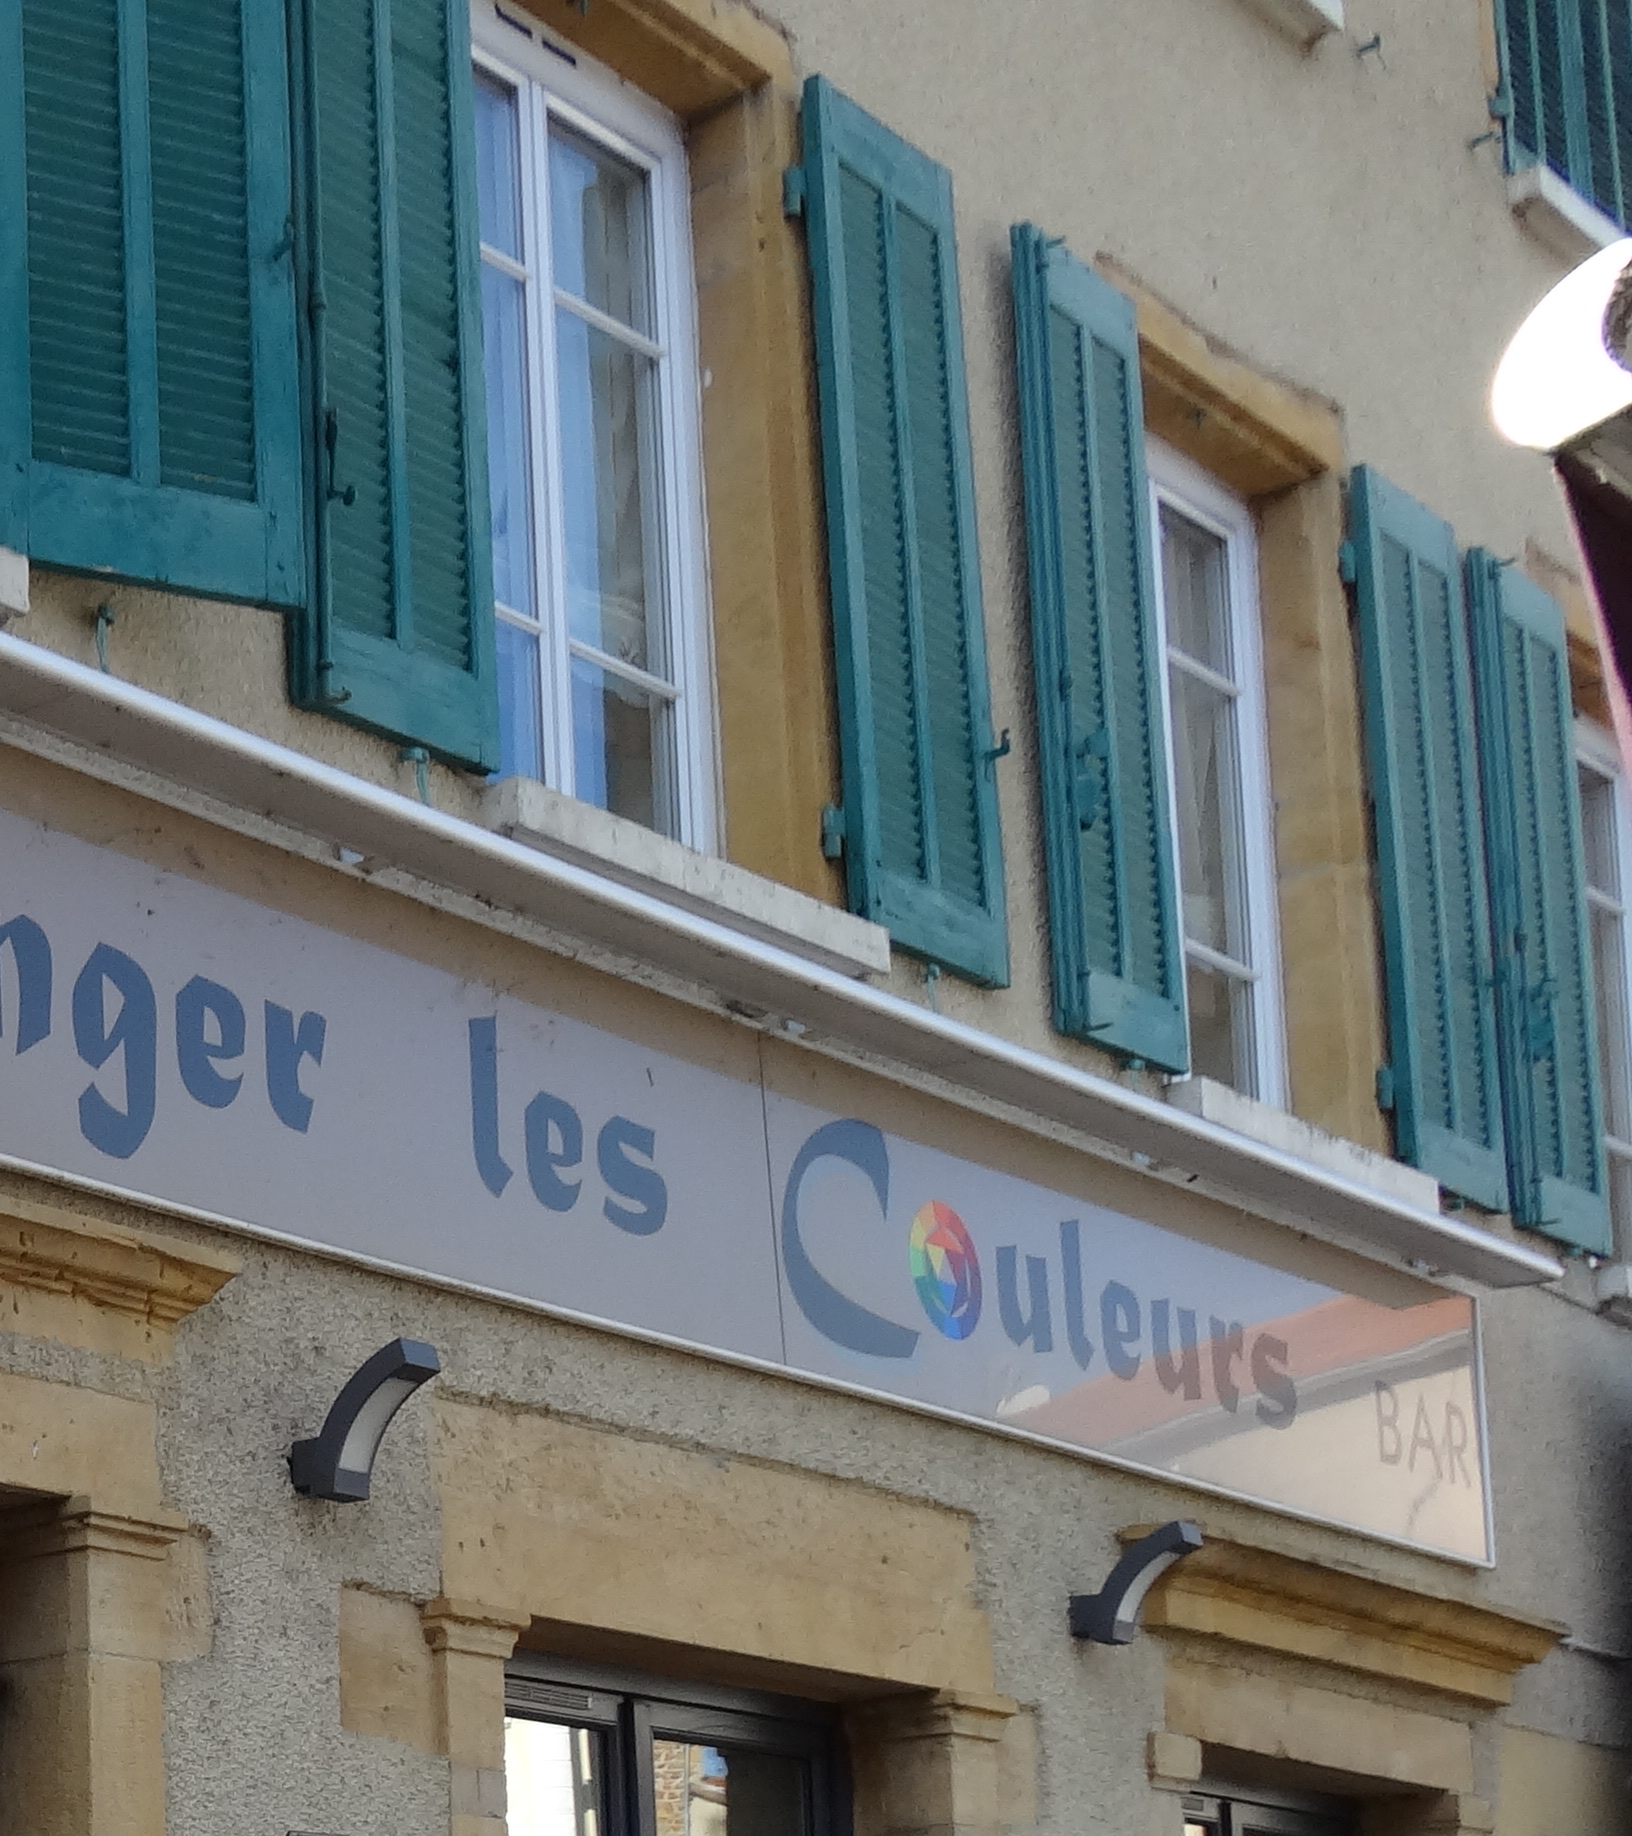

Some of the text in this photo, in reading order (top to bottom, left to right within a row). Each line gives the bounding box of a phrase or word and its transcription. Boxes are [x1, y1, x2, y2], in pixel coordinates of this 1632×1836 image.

[469, 1015, 668, 1236] les
[782, 1118, 1298, 1430] Couleurs
[1375, 1380, 1472, 1488] BAR
